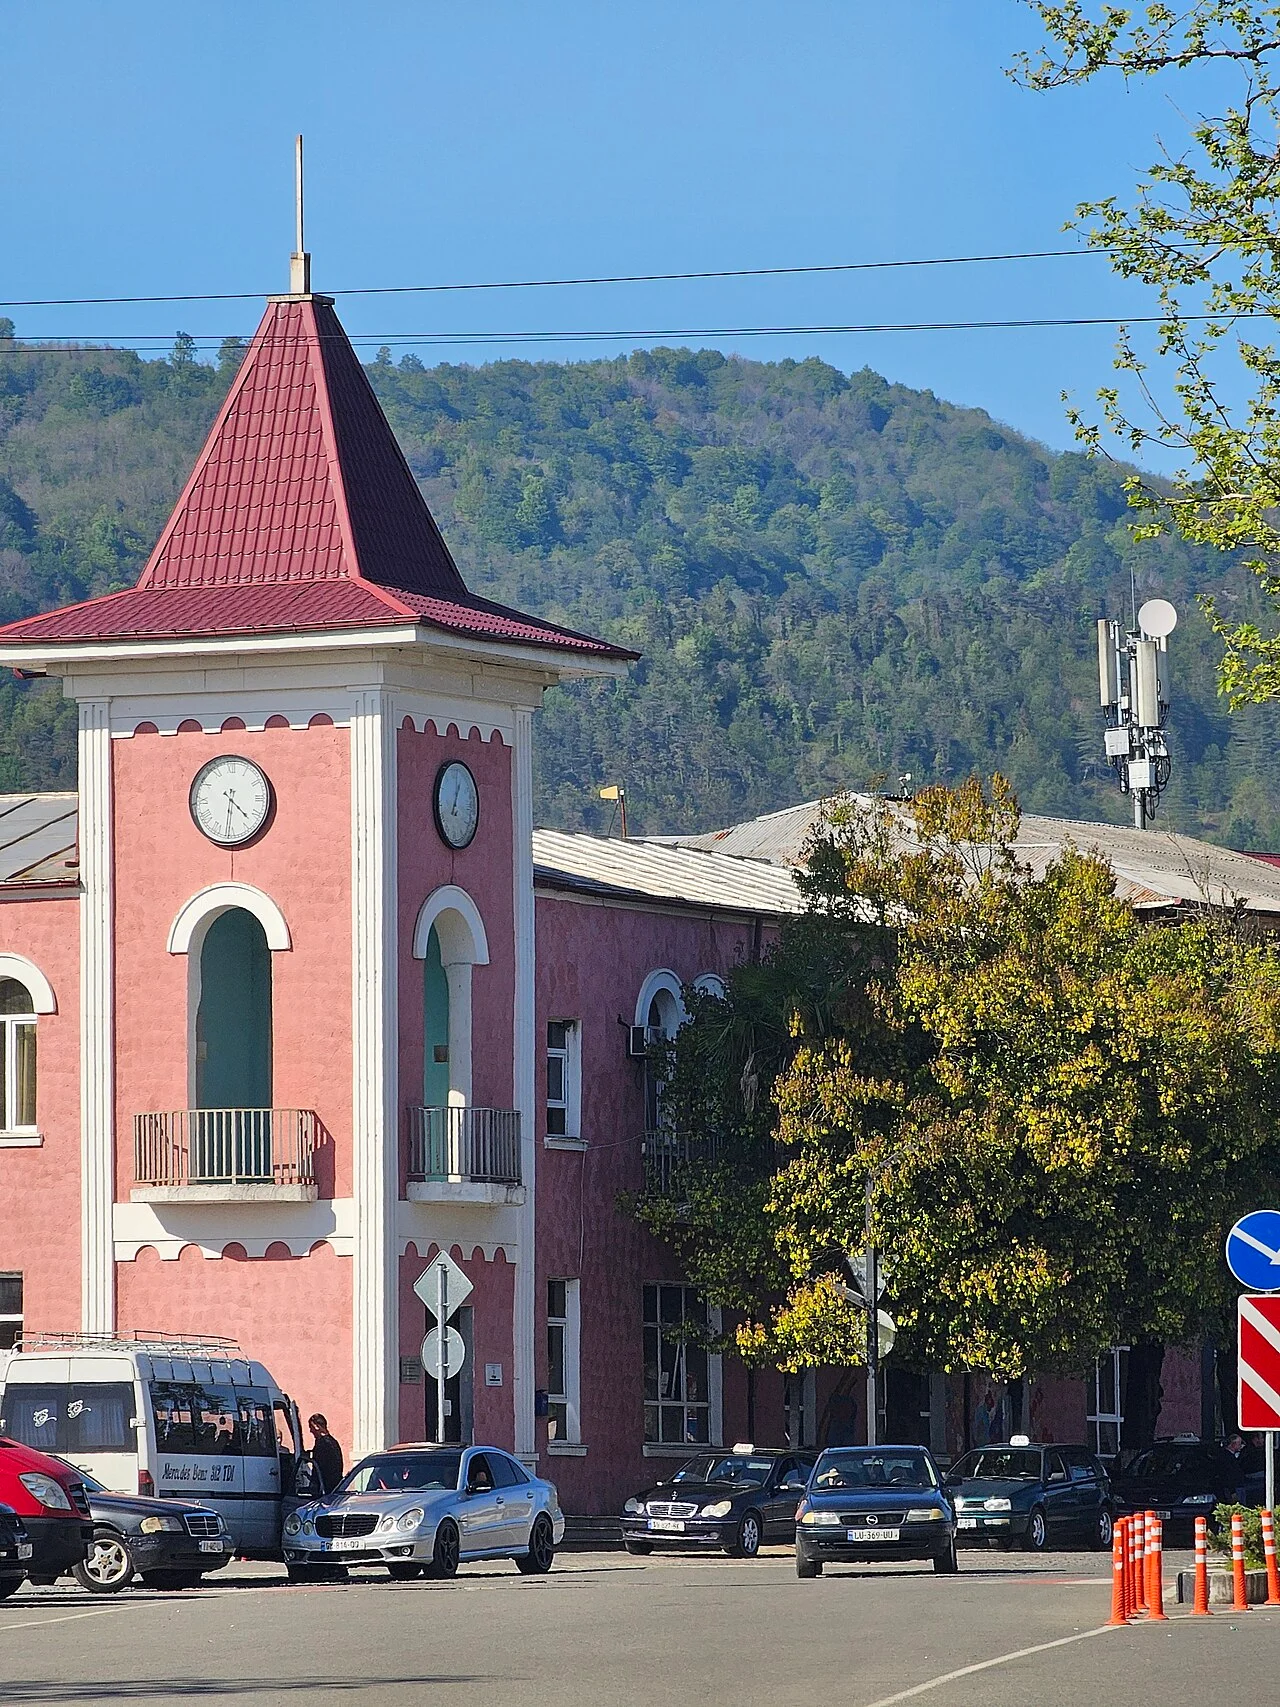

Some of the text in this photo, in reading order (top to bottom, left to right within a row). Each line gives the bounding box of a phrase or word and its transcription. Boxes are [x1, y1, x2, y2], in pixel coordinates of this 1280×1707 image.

[162, 1462, 191, 1480] Mercedes
[192, 1463, 208, 1481] Benz
[222, 1464, 236, 1482] TDI
